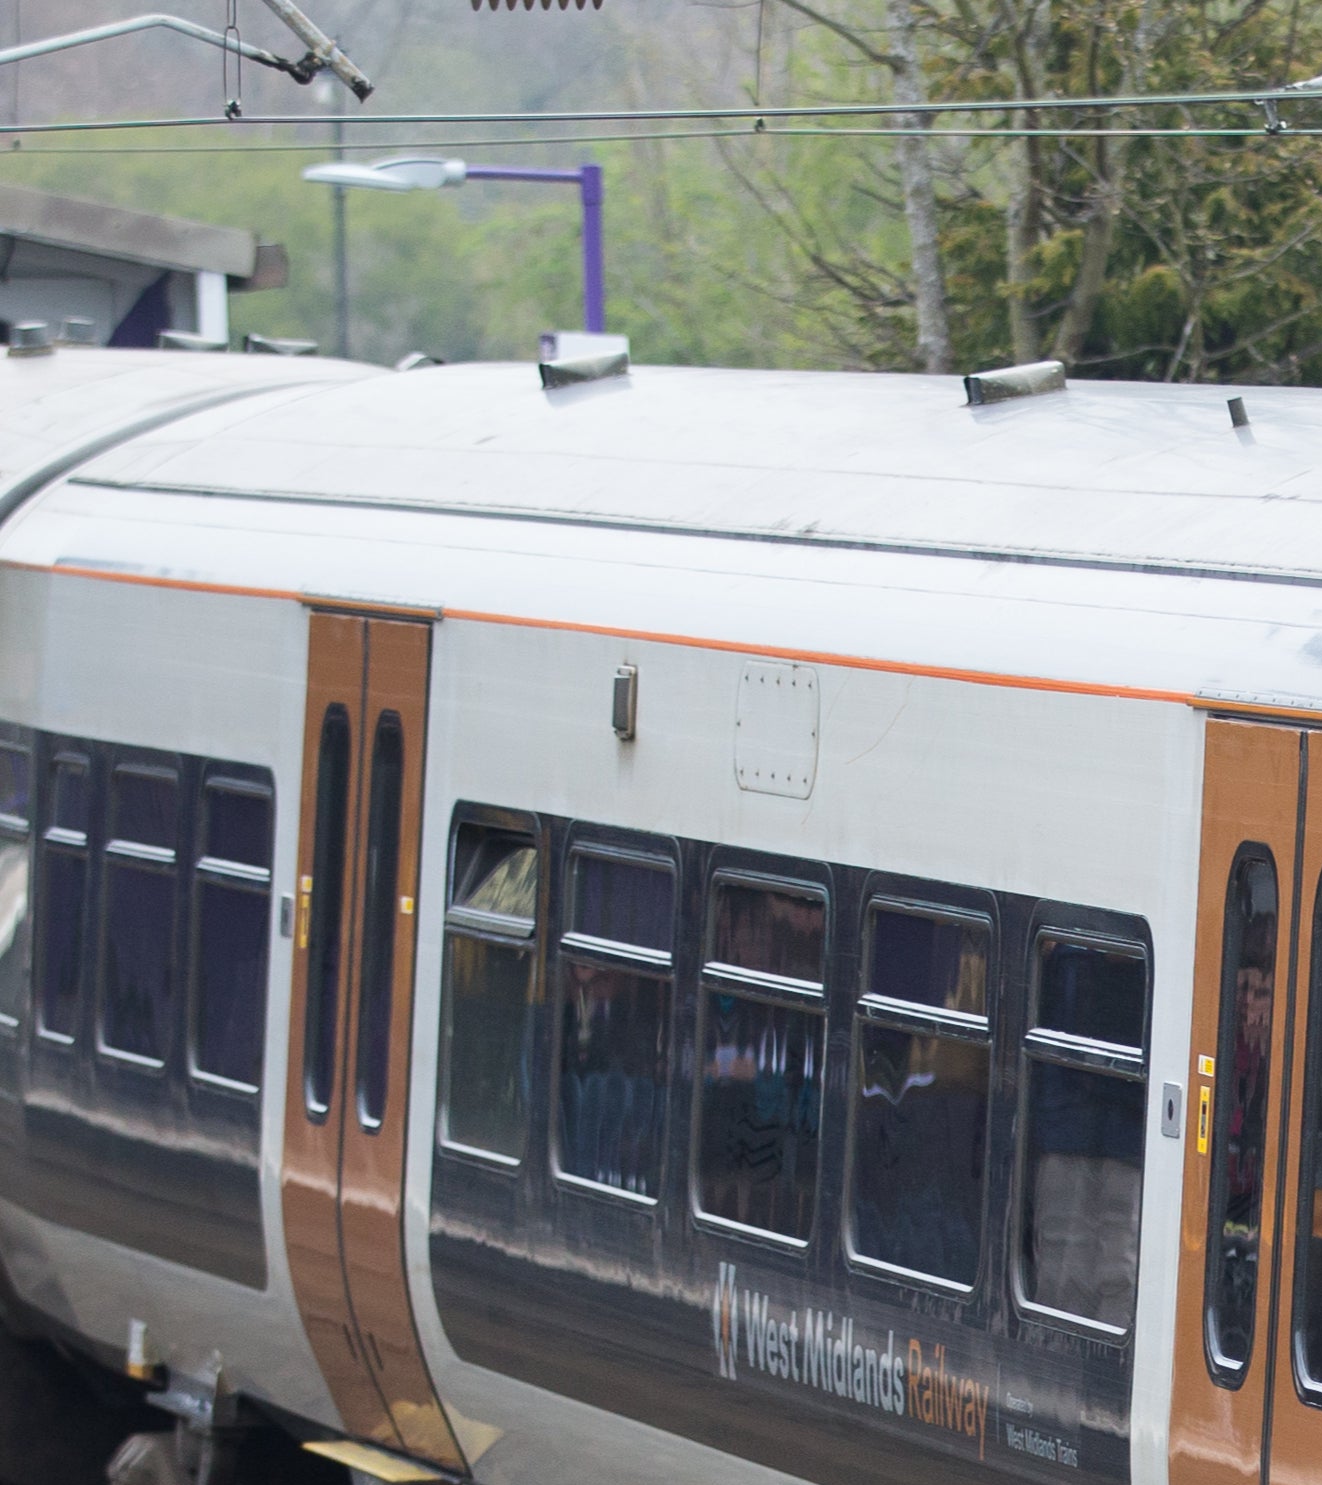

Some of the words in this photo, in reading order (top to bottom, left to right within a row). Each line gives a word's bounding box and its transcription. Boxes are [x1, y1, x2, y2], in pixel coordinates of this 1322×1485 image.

[744, 1289, 800, 1383] West
[803, 1307, 905, 1416] Midlands
[908, 1338, 989, 1461] Railway
[1006, 1422, 1025, 1452] West
[1024, 1427, 1057, 1461] Midlands
[1056, 1438, 1078, 1468] Trains
